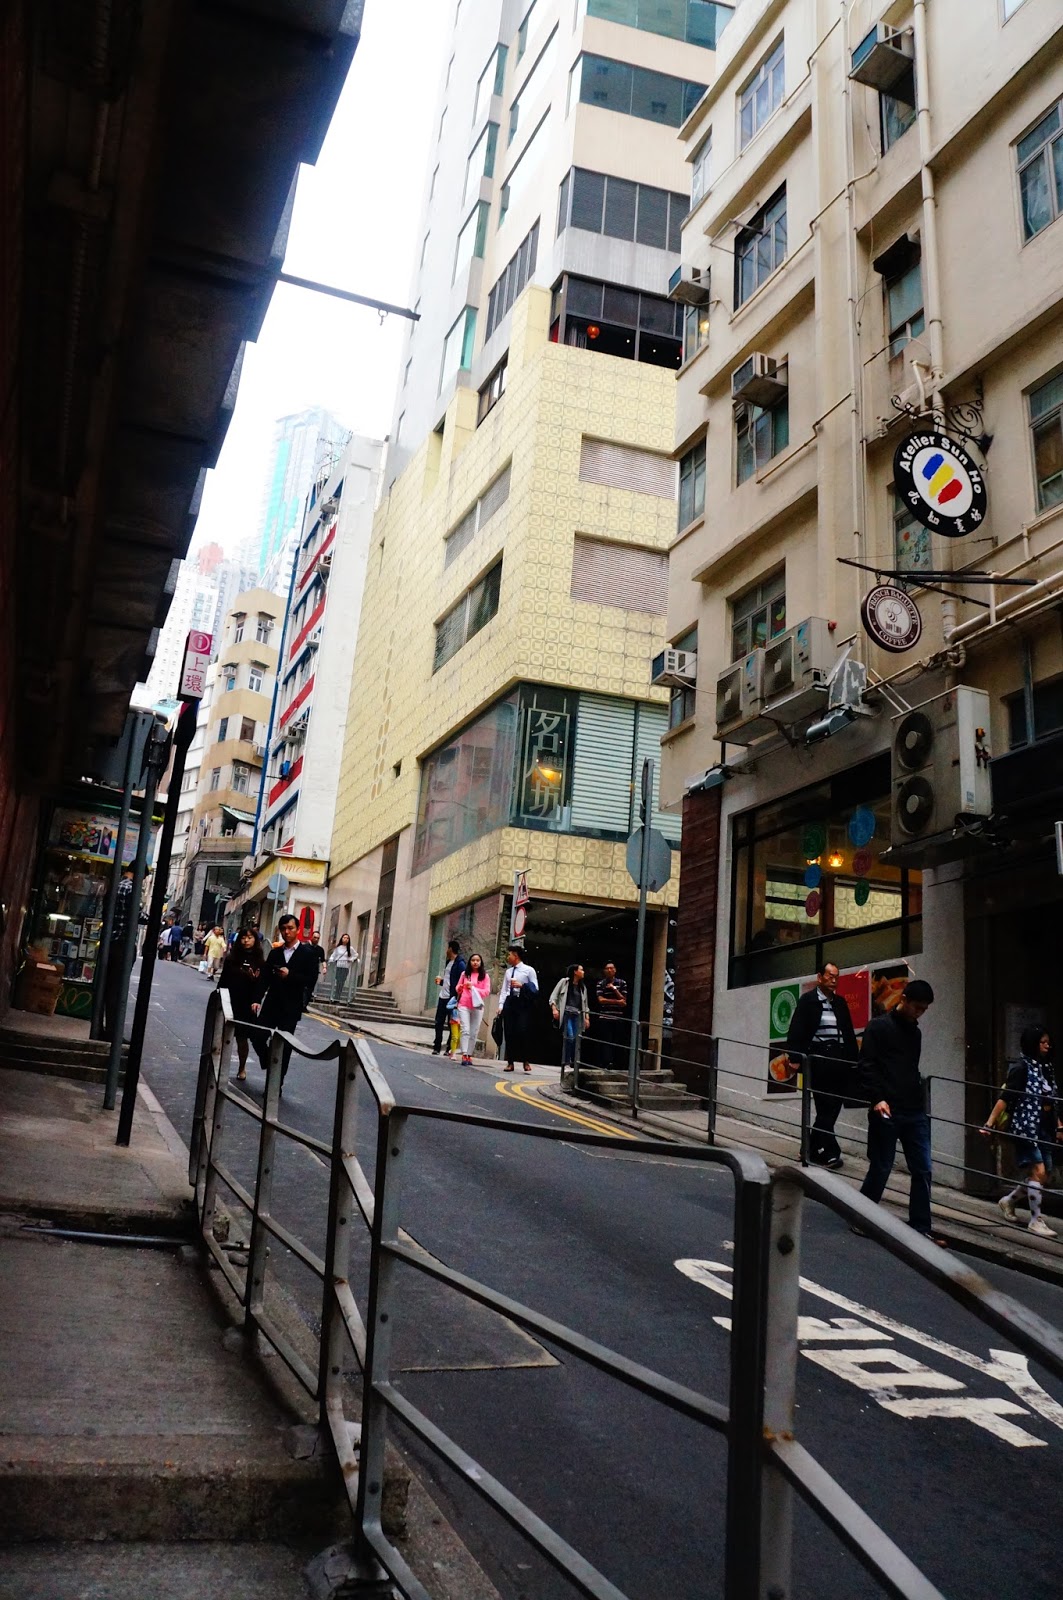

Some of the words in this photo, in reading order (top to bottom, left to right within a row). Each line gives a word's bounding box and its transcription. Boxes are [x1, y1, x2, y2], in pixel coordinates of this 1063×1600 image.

[899, 435, 935, 473] Atelier
[941, 437, 968, 465] Sun
[968, 470, 982, 494] Ho
[869, 589, 890, 610] FRENCH
[890, 590, 918, 625] BAGUETTE
[878, 630, 907, 646] COFFEE
[184, 656, 205, 692] 上環
[524, 712, 561, 817] 名人坊
